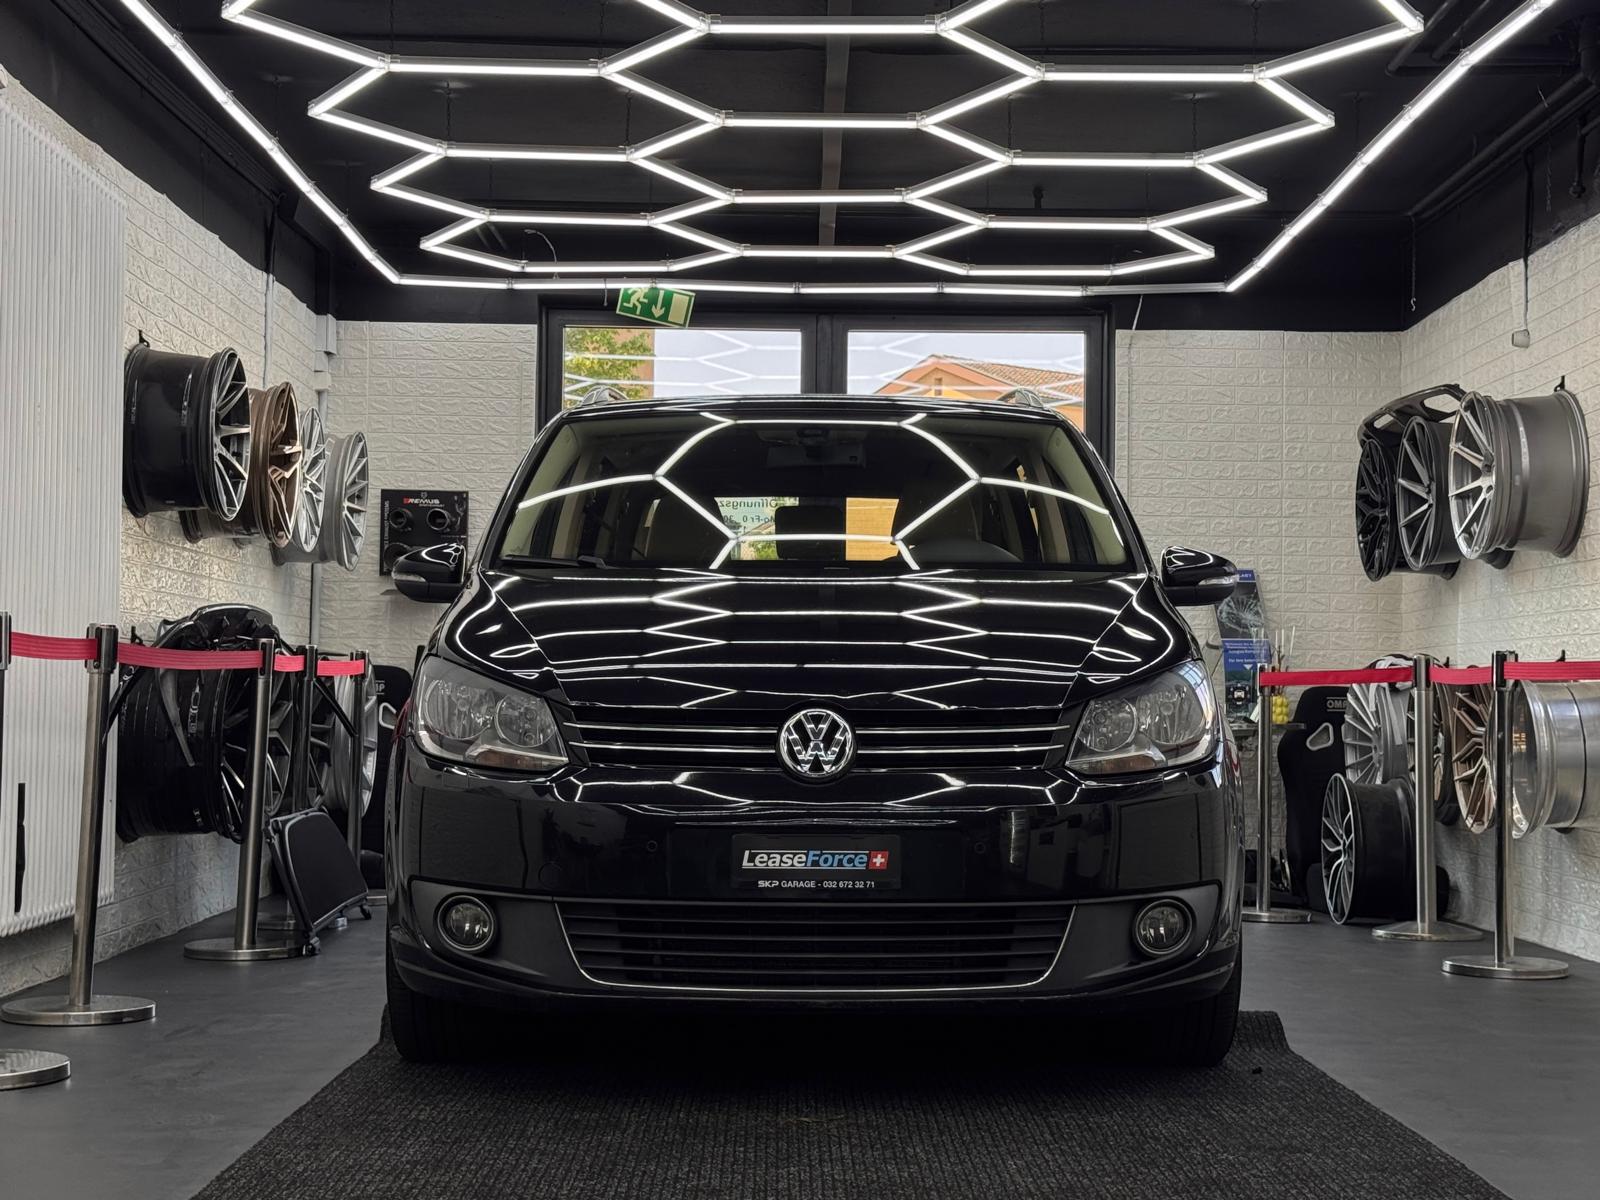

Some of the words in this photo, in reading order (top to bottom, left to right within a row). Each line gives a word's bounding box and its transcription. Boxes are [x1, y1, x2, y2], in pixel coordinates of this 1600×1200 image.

[742, 850, 868, 867] LeaseForce
[758, 880, 779, 888] SKP
[781, 880, 816, 888] GARAGE
